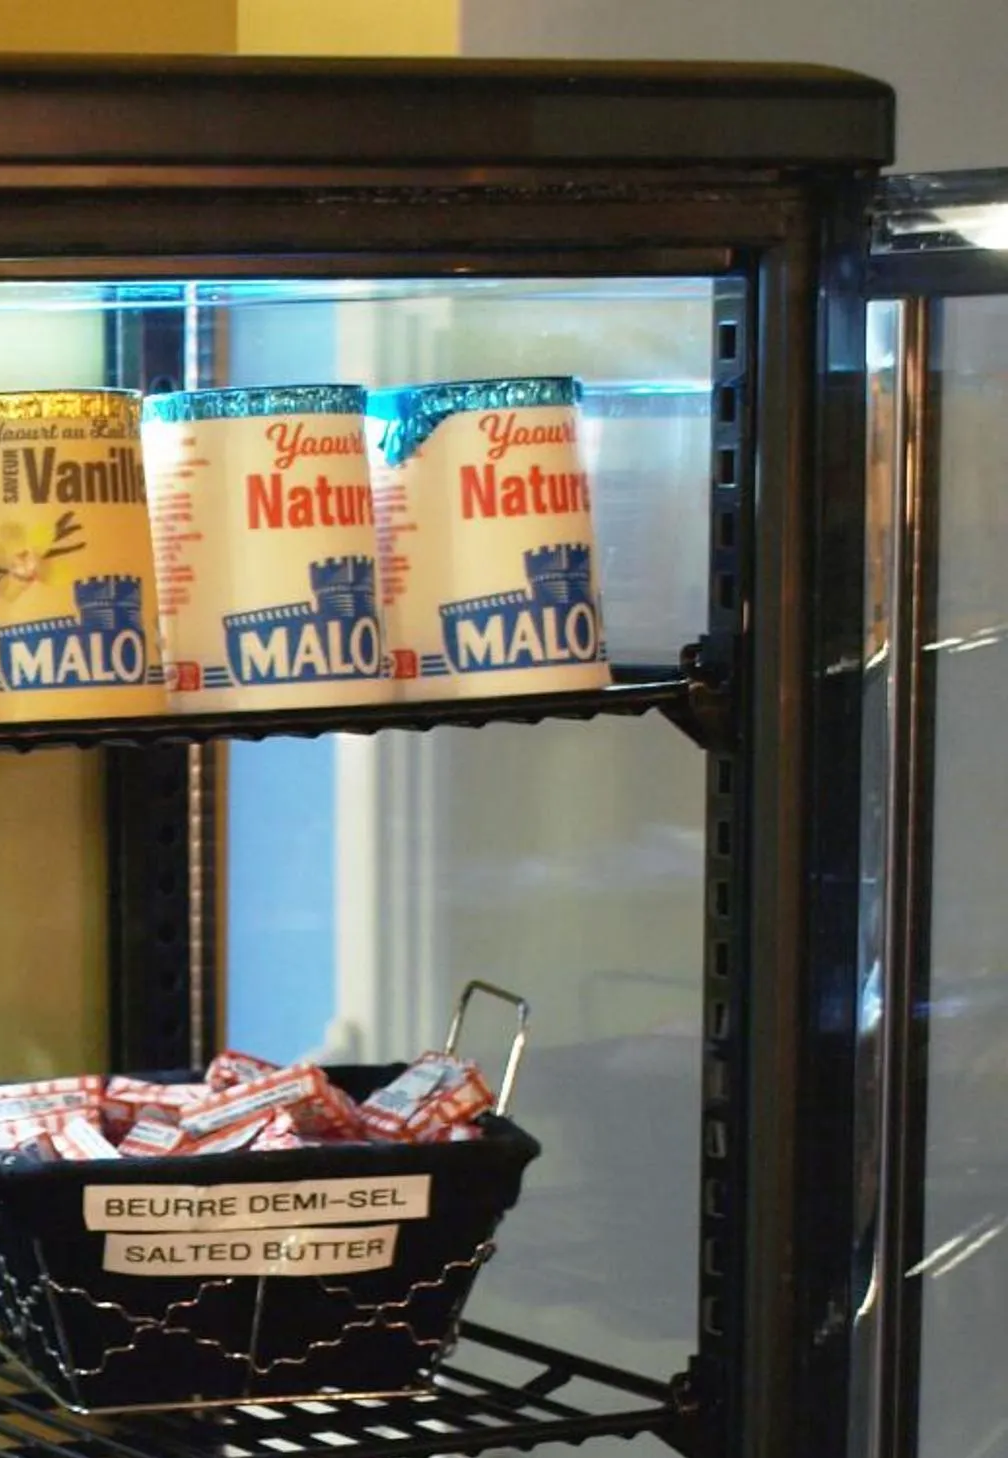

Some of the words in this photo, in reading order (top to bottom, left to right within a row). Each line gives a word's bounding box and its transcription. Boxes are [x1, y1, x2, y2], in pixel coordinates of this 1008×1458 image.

[9, 629, 142, 686] MALO
[238, 615, 381, 682] MALO
[455, 604, 597, 670] MALO
[104, 1195, 238, 1219] BEURRE
[248, 1188, 407, 1214] DEMI-SEL
[124, 1242, 253, 1264] SALTED
[263, 1237, 385, 1263] BUTTER
